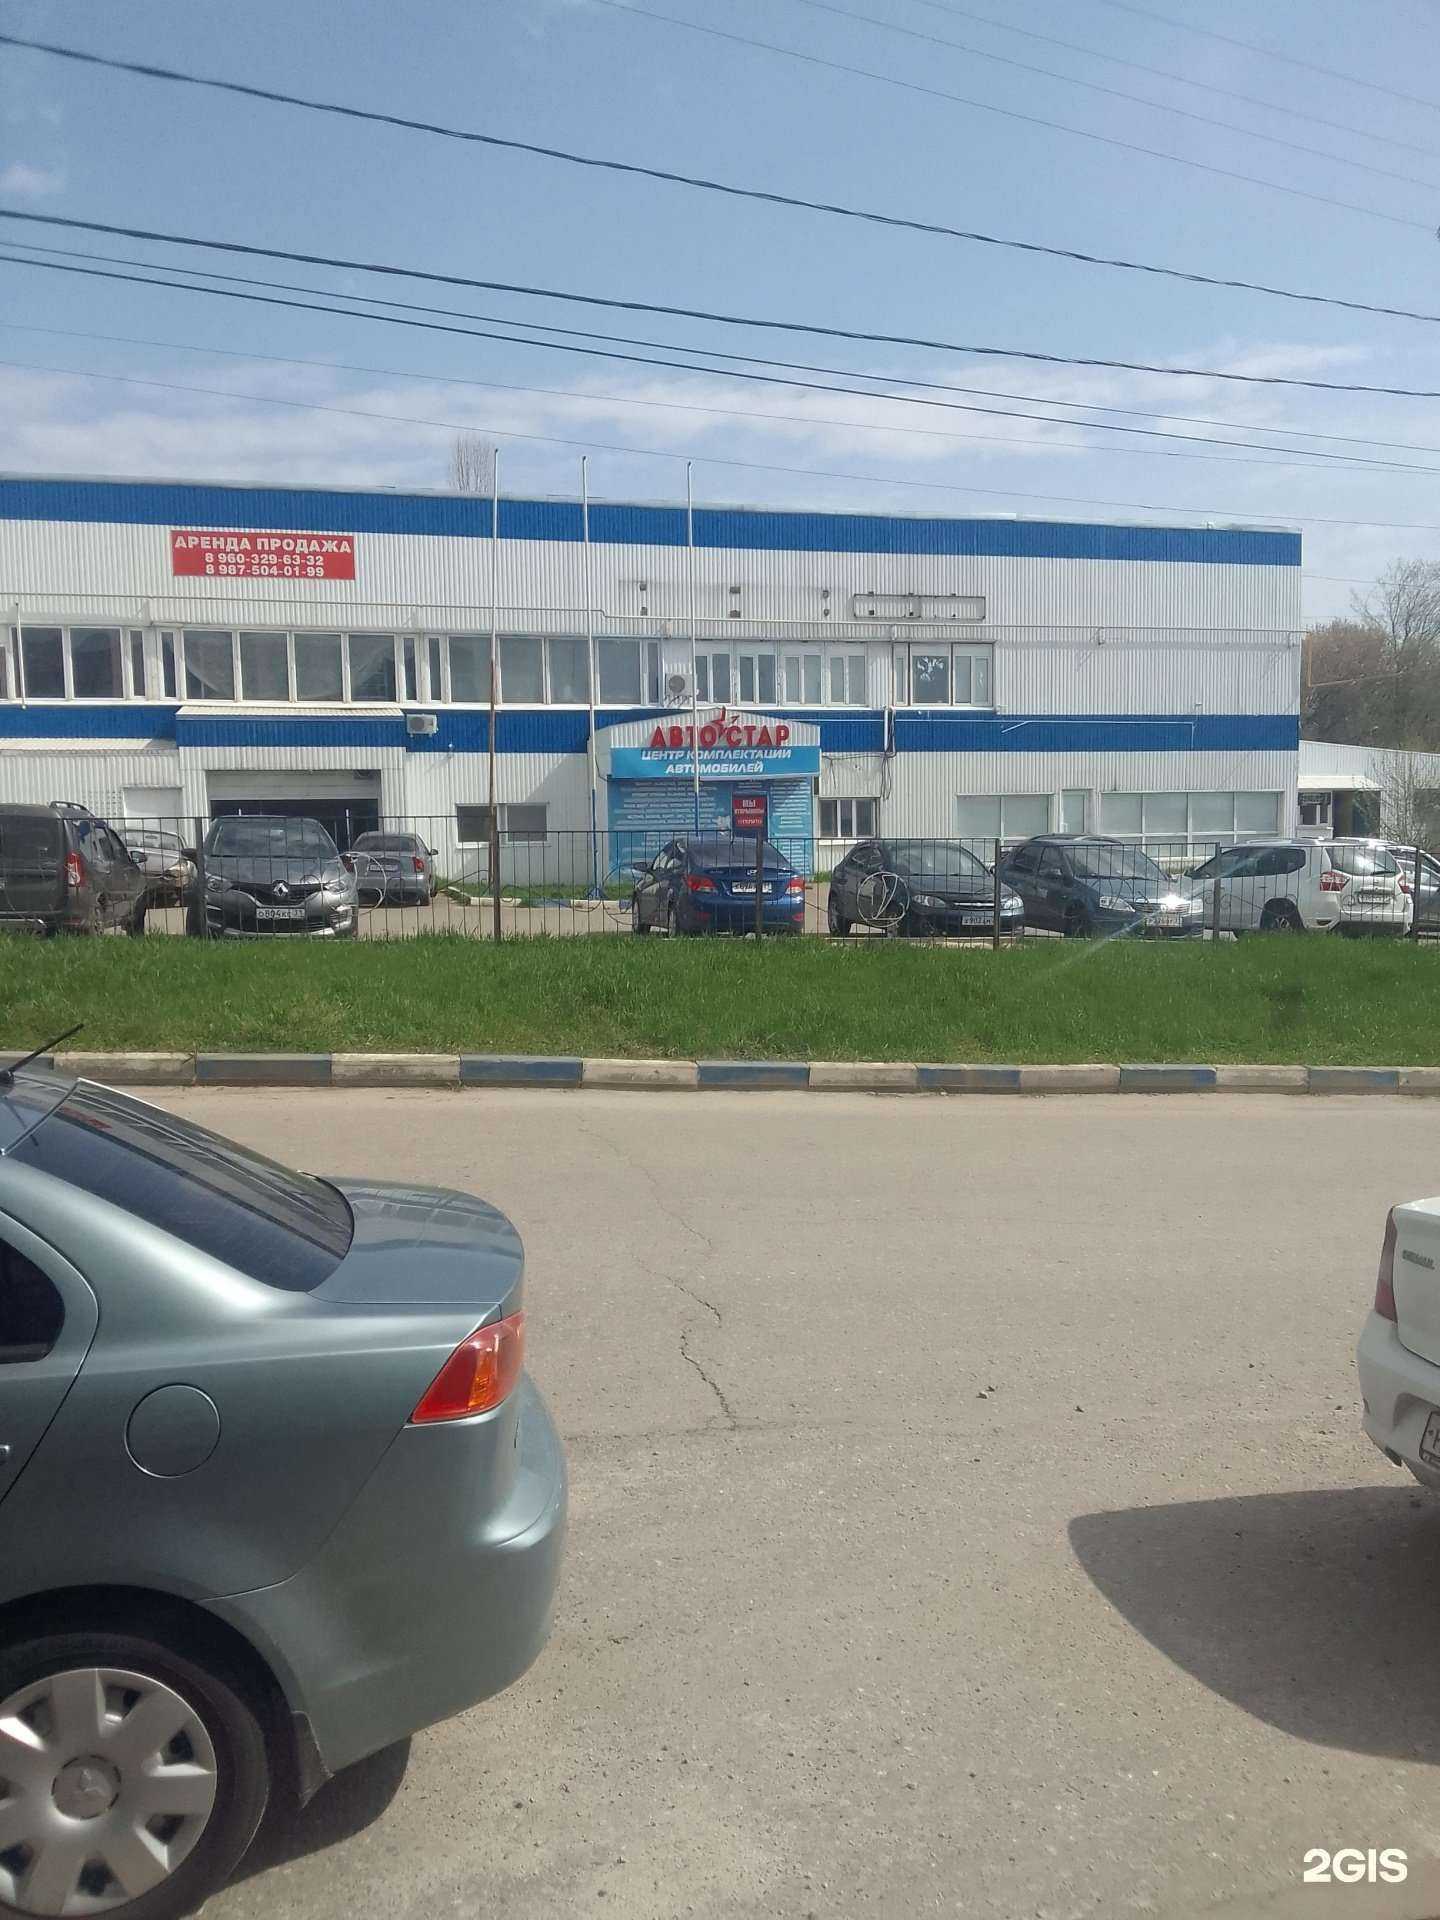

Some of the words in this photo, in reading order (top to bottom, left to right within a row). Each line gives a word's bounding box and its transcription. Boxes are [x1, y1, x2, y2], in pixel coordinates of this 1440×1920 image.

[174, 536, 251, 552] АРЕНДА
[256, 538, 352, 553] ПРОДАЖА
[205, 553, 214, 562] 8
[205, 565, 214, 574] 8
[641, 750, 685, 761] ЦЕНТР
[687, 749, 792, 761] КОМПЛЕКТАЦИИ
[665, 761, 764, 774] АВТОМОБИЛЕЙ
